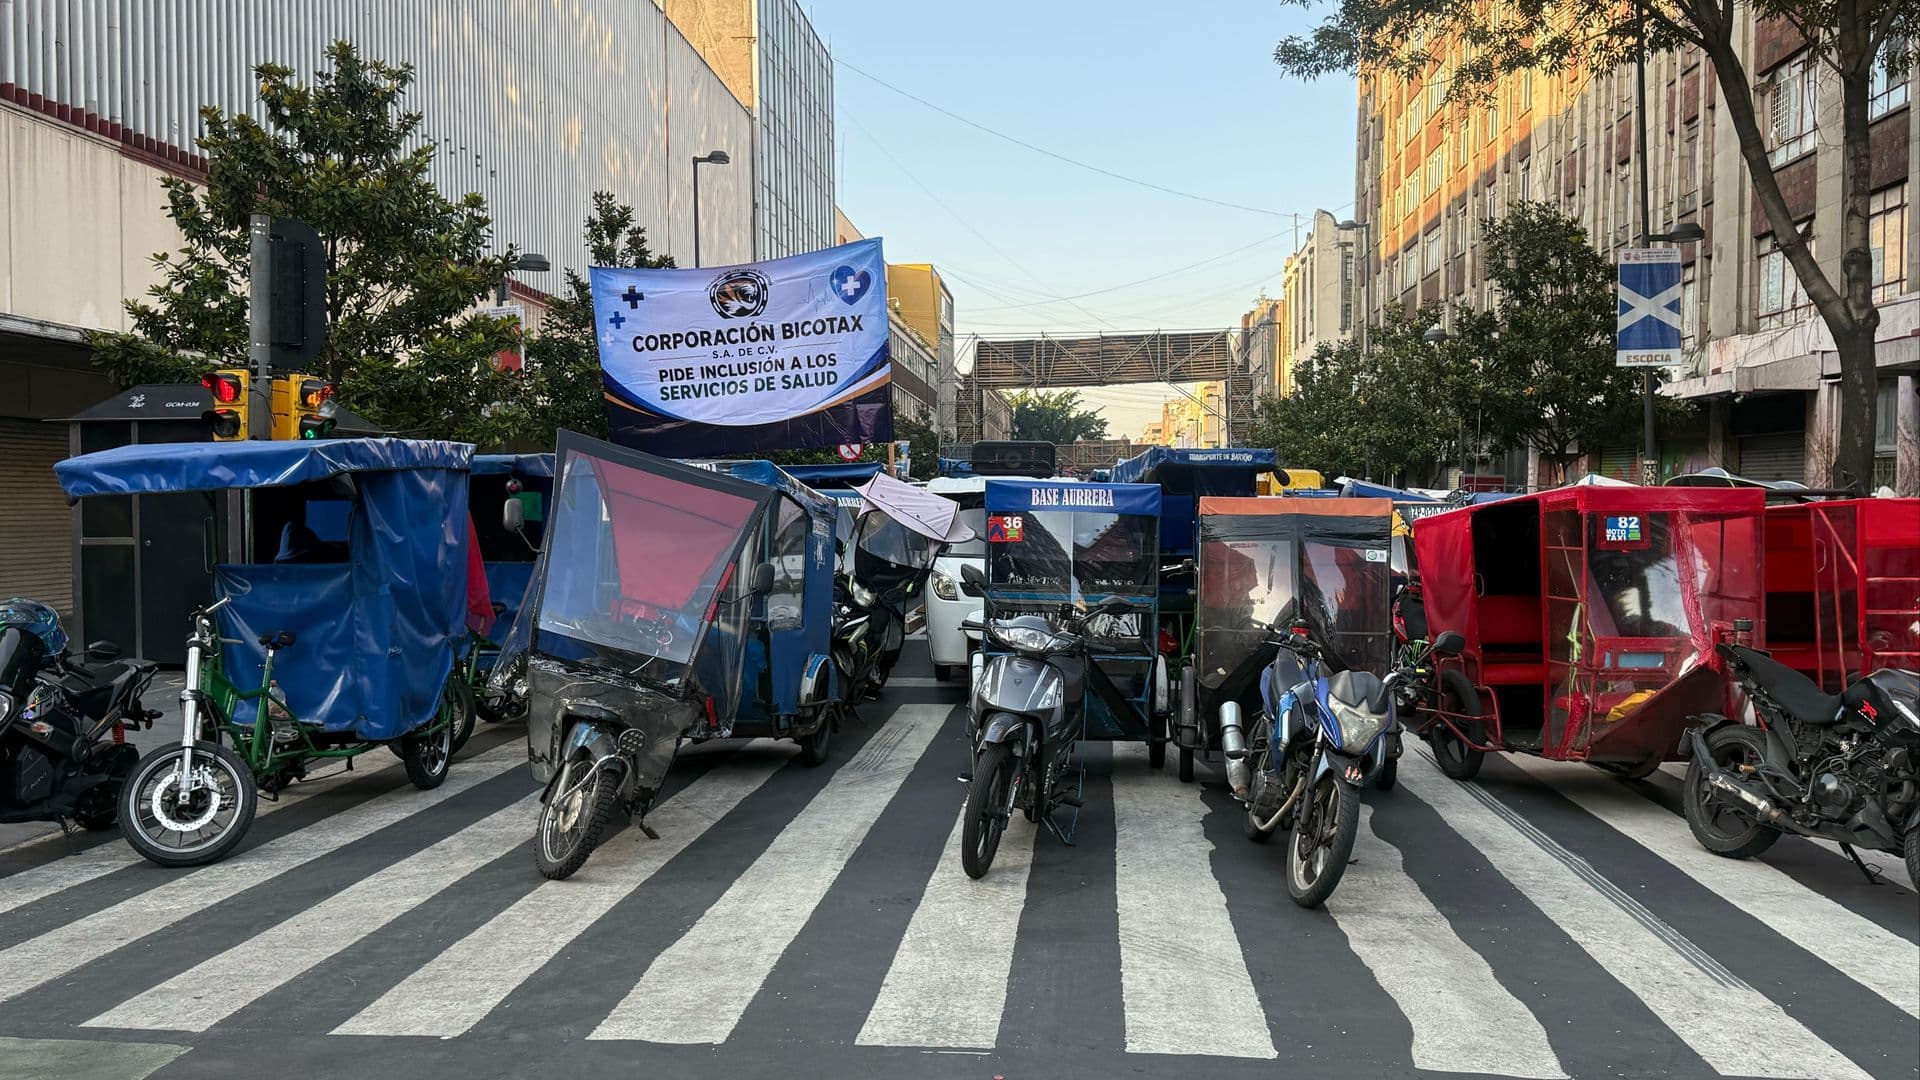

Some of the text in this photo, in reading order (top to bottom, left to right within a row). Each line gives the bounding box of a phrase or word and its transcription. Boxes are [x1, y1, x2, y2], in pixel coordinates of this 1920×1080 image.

[632, 314, 864, 353] CORPORACIÓN BICOTAX
[712, 345, 778, 359] S.A. DE C.V.
[1626, 353, 1672, 363] ESCOCIA
[659, 353, 837, 383] PIDE INCLUSIÓN A LOS
[660, 370, 838, 401] SERVICIOS DE SALUD
[1031, 488, 1114, 507] BASE AURRERA
[1003, 516, 1022, 529] 36
[1618, 516, 1639, 528] 82
